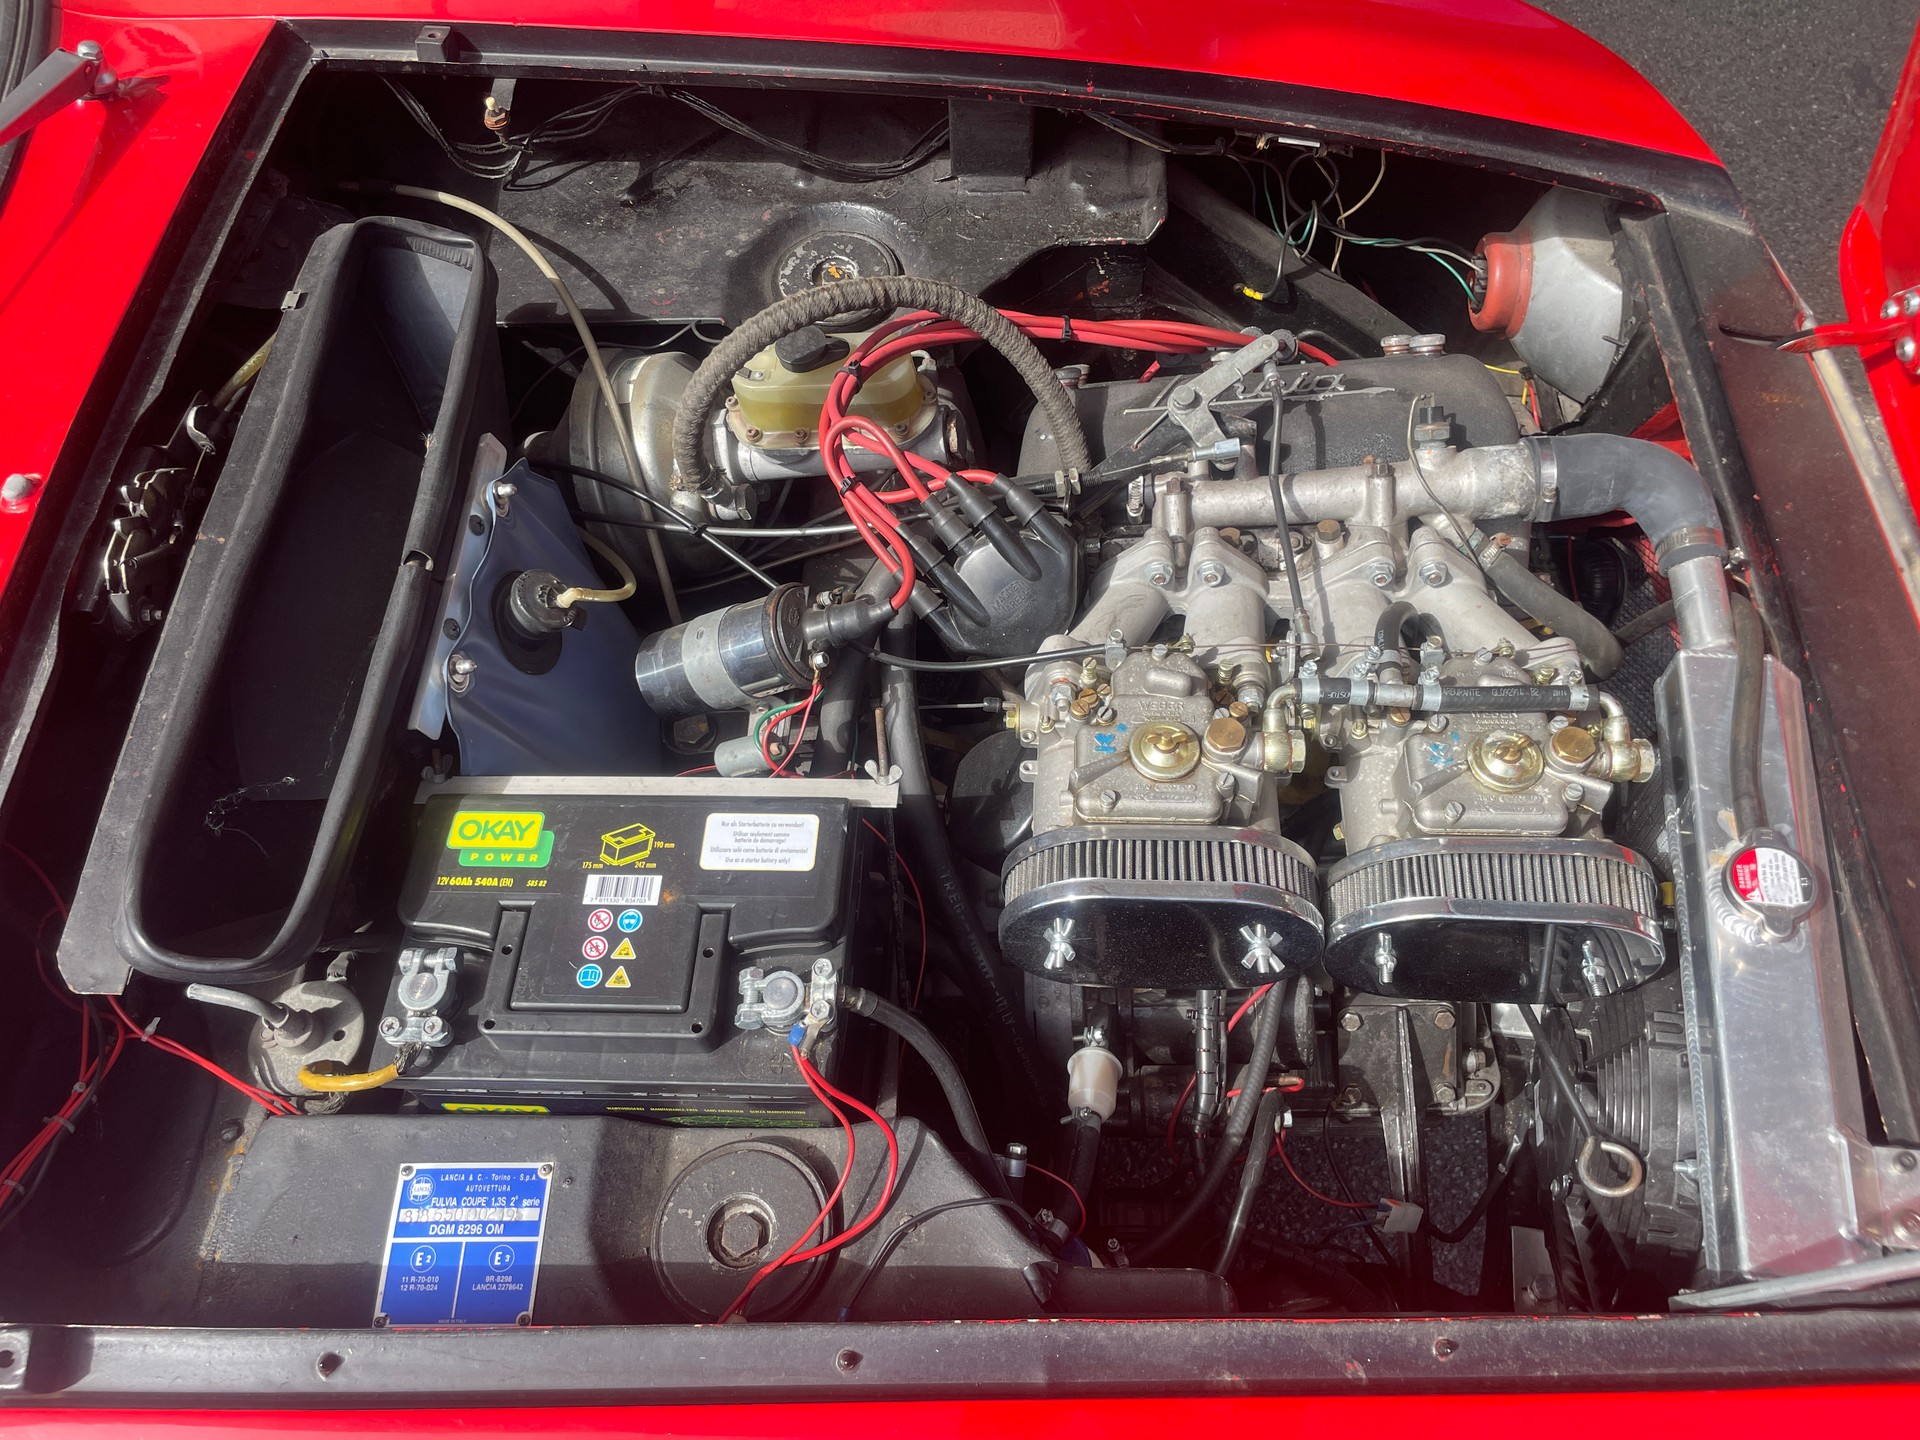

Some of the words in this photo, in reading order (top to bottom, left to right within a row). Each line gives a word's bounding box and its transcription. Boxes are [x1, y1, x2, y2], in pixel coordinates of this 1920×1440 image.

[1441, 688, 1480, 696] ARBURANTE
[1139, 700, 1184, 711] WEBER
[458, 819, 535, 841] OKAY
[469, 852, 539, 862] POWER
[582, 861, 592, 869] 175
[437, 876, 449, 886] 12V
[449, 876, 473, 886] 60Ah
[474, 877, 498, 887] 540A
[499, 877, 514, 888] (EN)
[1736, 864, 1745, 889] DANGER
[1743, 864, 1752, 889] WARNING
[440, 1173, 465, 1181] LANCIA
[469, 1173, 474, 1181] &
[491, 1173, 511, 1181] Torino
[465, 1184, 511, 1192] AUTOVETTURA
[431, 1197, 458, 1207] FULVIA
[522, 1197, 540, 1207] serie
[428, 1224, 455, 1236] DGM
[457, 1224, 483, 1235] 8296
[485, 1223, 505, 1235] OM
[415, 1252, 425, 1266] E
[426, 1255, 432, 1263] 2
[494, 1251, 503, 1266] E
[505, 1254, 511, 1263] 3
